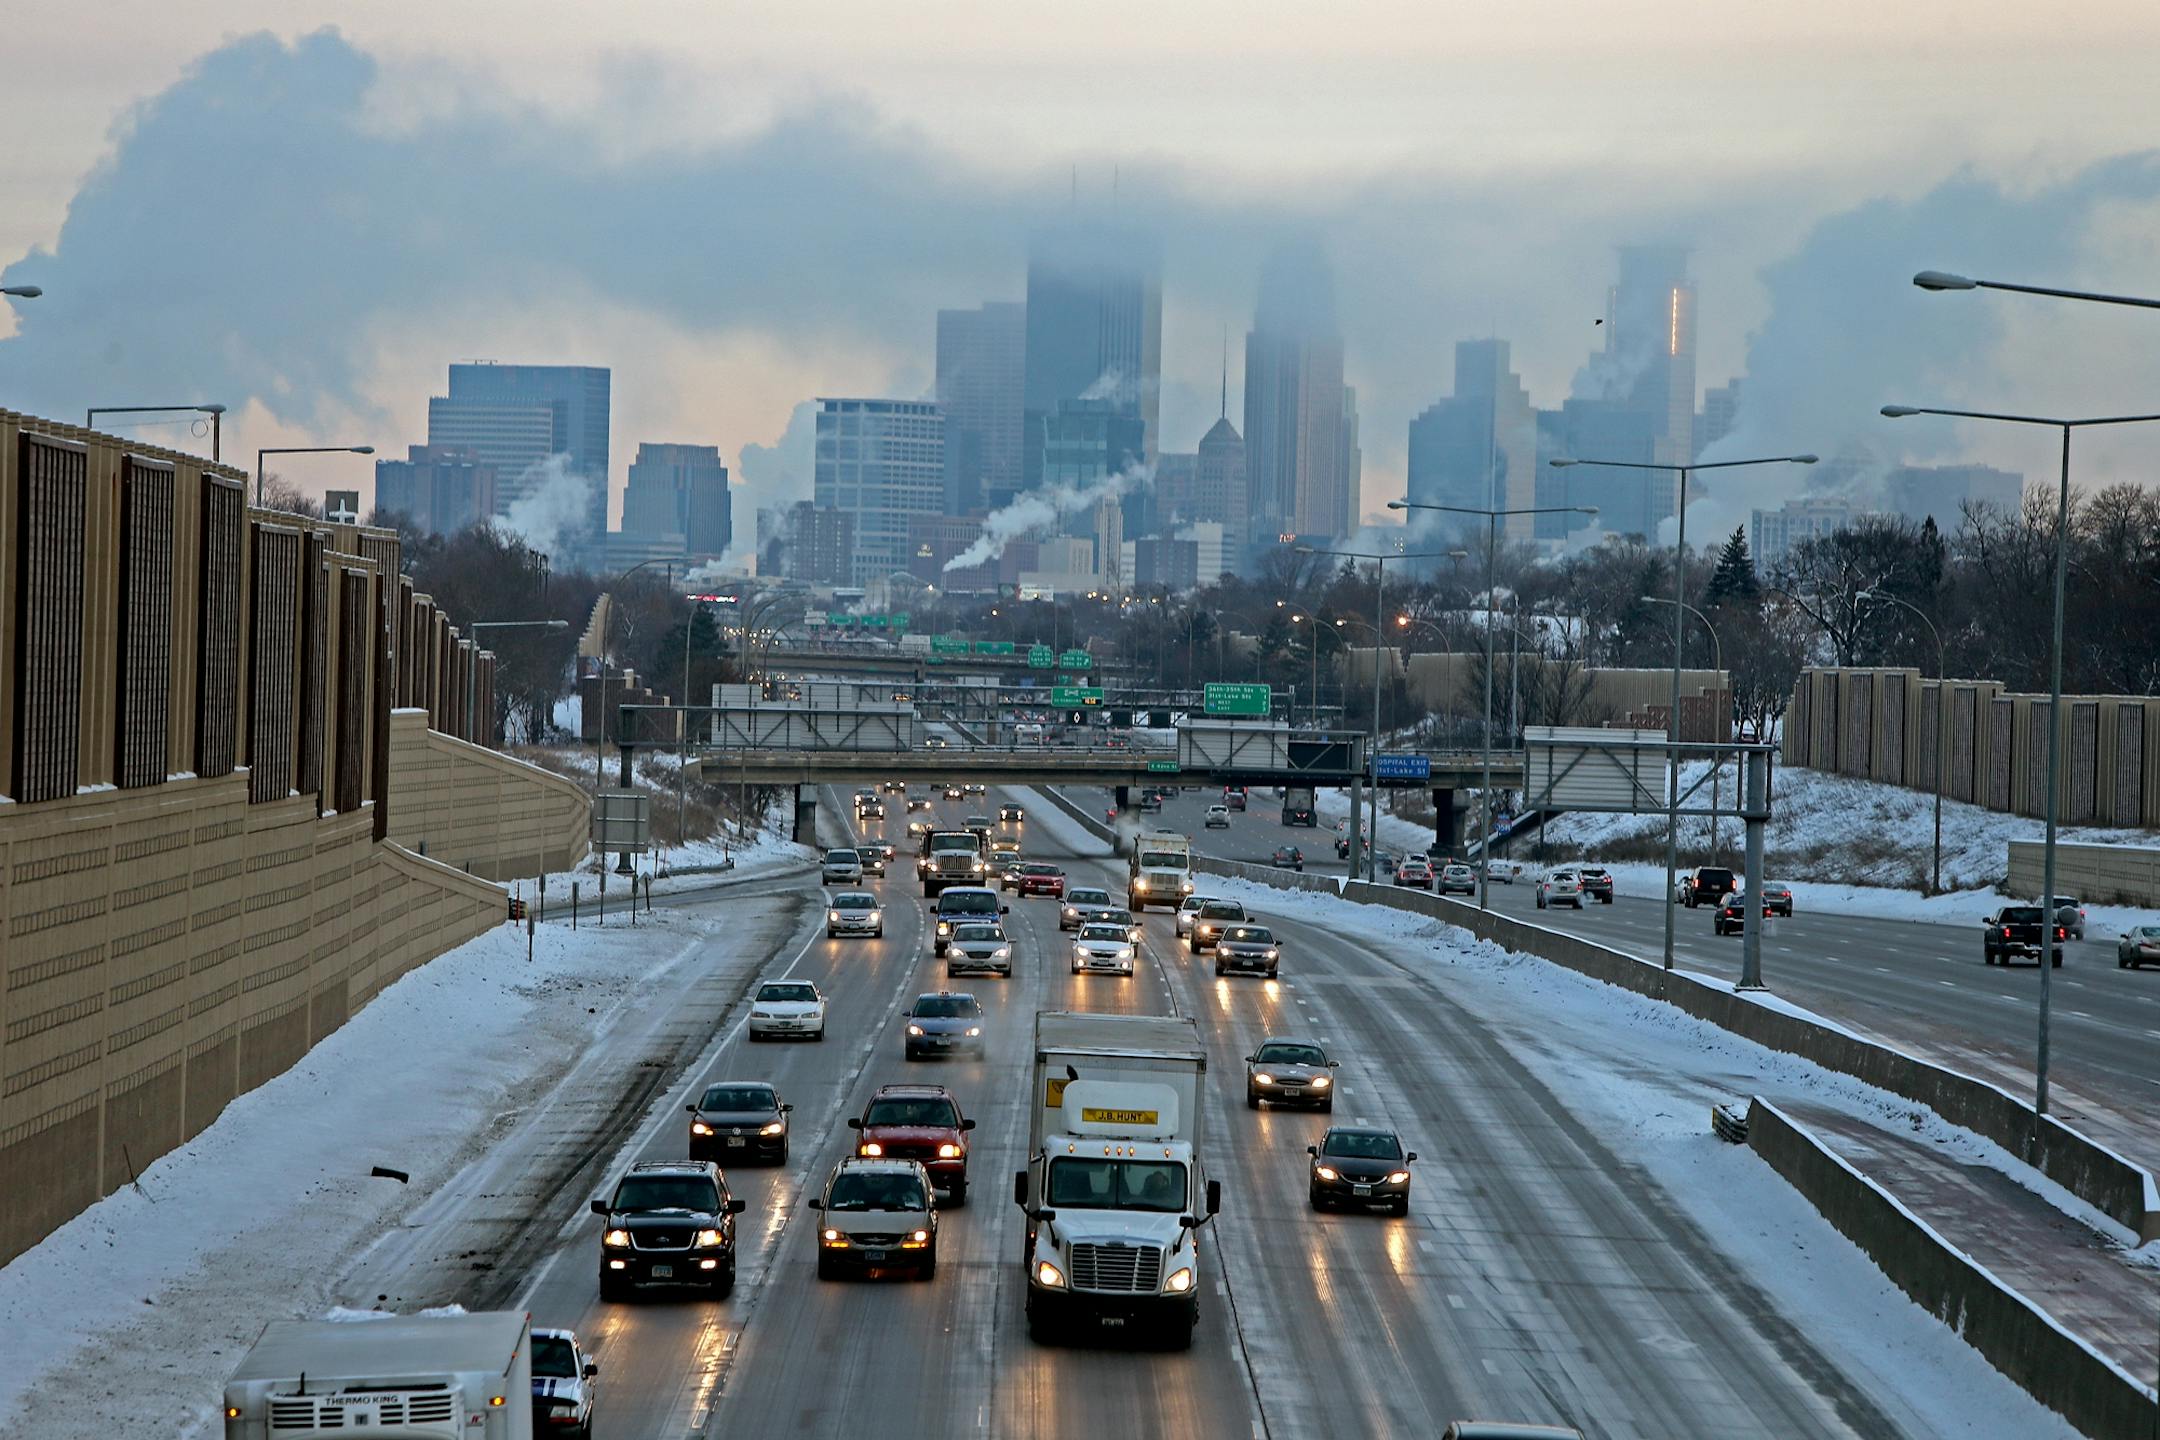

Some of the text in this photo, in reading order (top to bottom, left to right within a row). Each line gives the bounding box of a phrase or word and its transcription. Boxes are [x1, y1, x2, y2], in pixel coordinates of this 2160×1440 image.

[1098, 1111, 1145, 1122] J.B. HUNT
[325, 1395, 399, 1406] THERMO KING
